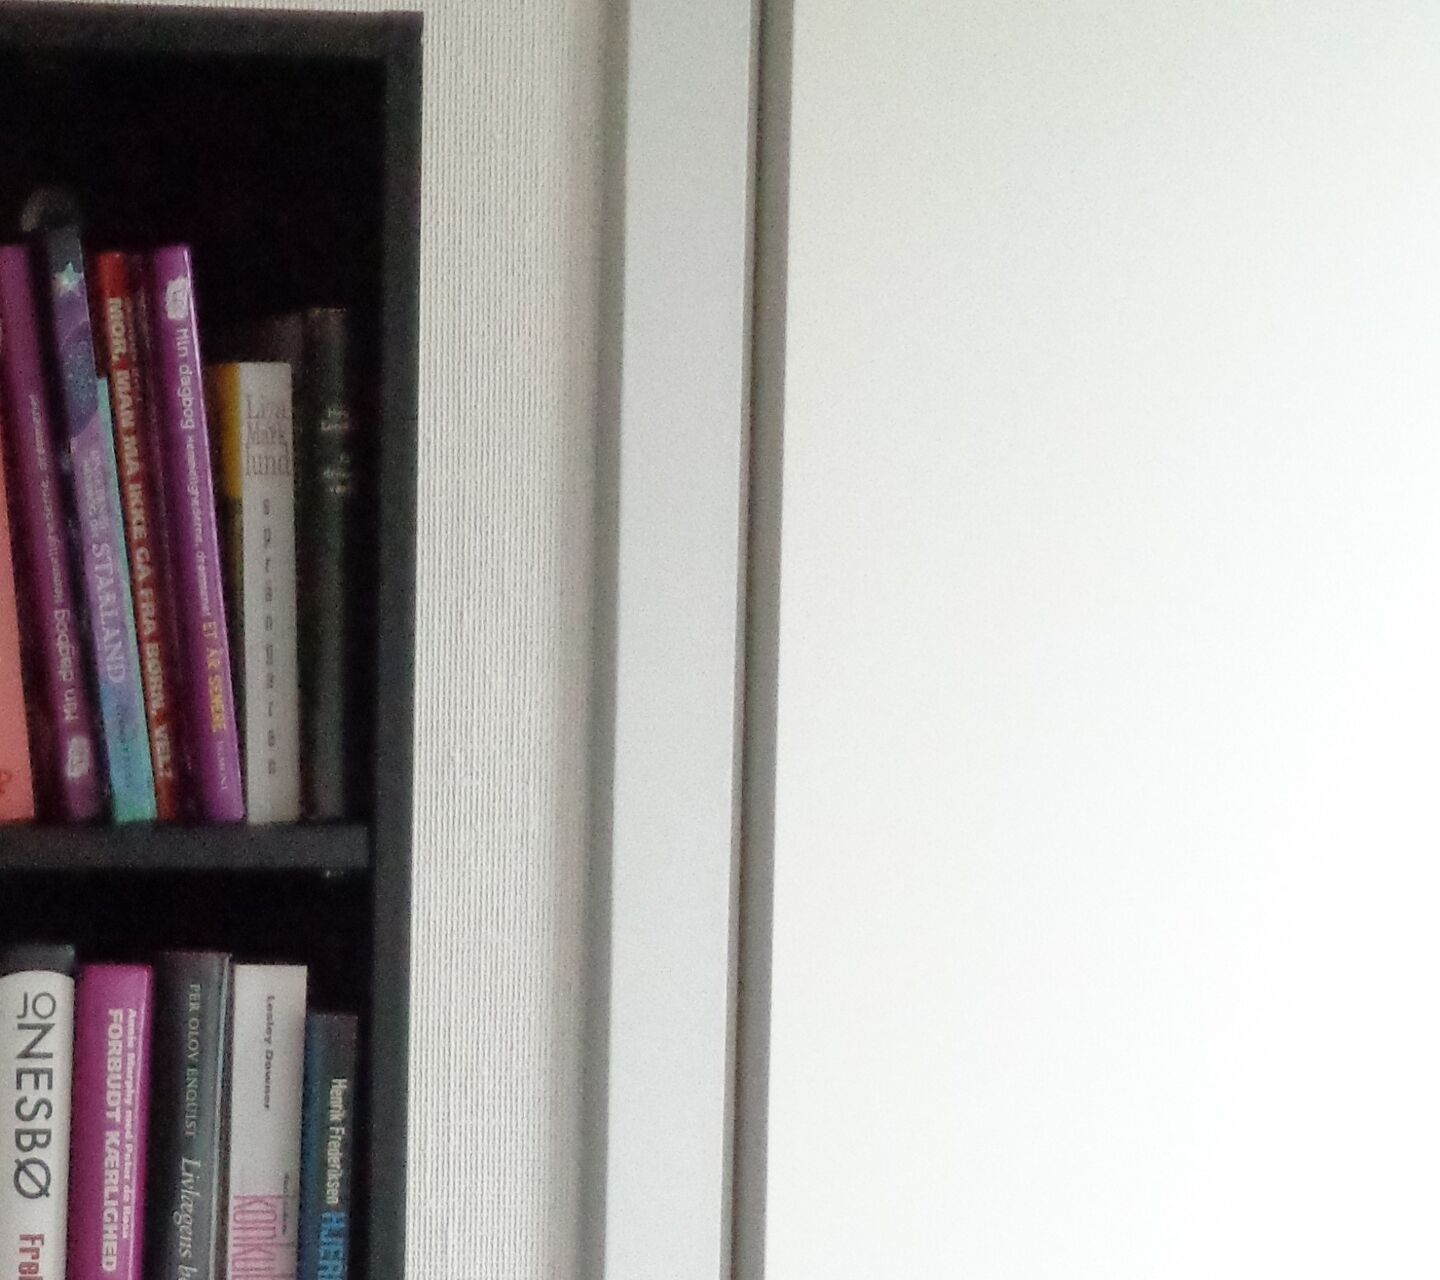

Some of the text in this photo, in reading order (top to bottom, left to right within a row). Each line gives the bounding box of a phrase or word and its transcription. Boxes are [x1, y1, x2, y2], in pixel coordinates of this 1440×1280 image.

[177, 327, 196, 363] Min
[179, 366, 201, 431] dagbog
[114, 369, 137, 430] MAN
[127, 482, 151, 541] IKKE
[139, 590, 159, 638] FRA
[91, 543, 127, 685] STARLAND
[15, 990, 58, 1021] JO
[185, 982, 202, 1137] PER OLOV ENQUIST
[262, 994, 277, 1110] Lesley Downer
[13, 1022, 55, 1200] NESBØ
[101, 1007, 124, 1273] FORBUDT KÆRLIGHED
[326, 1078, 348, 1205] Henrik Frederiksen
[170, 1156, 202, 1258] Livlægens
